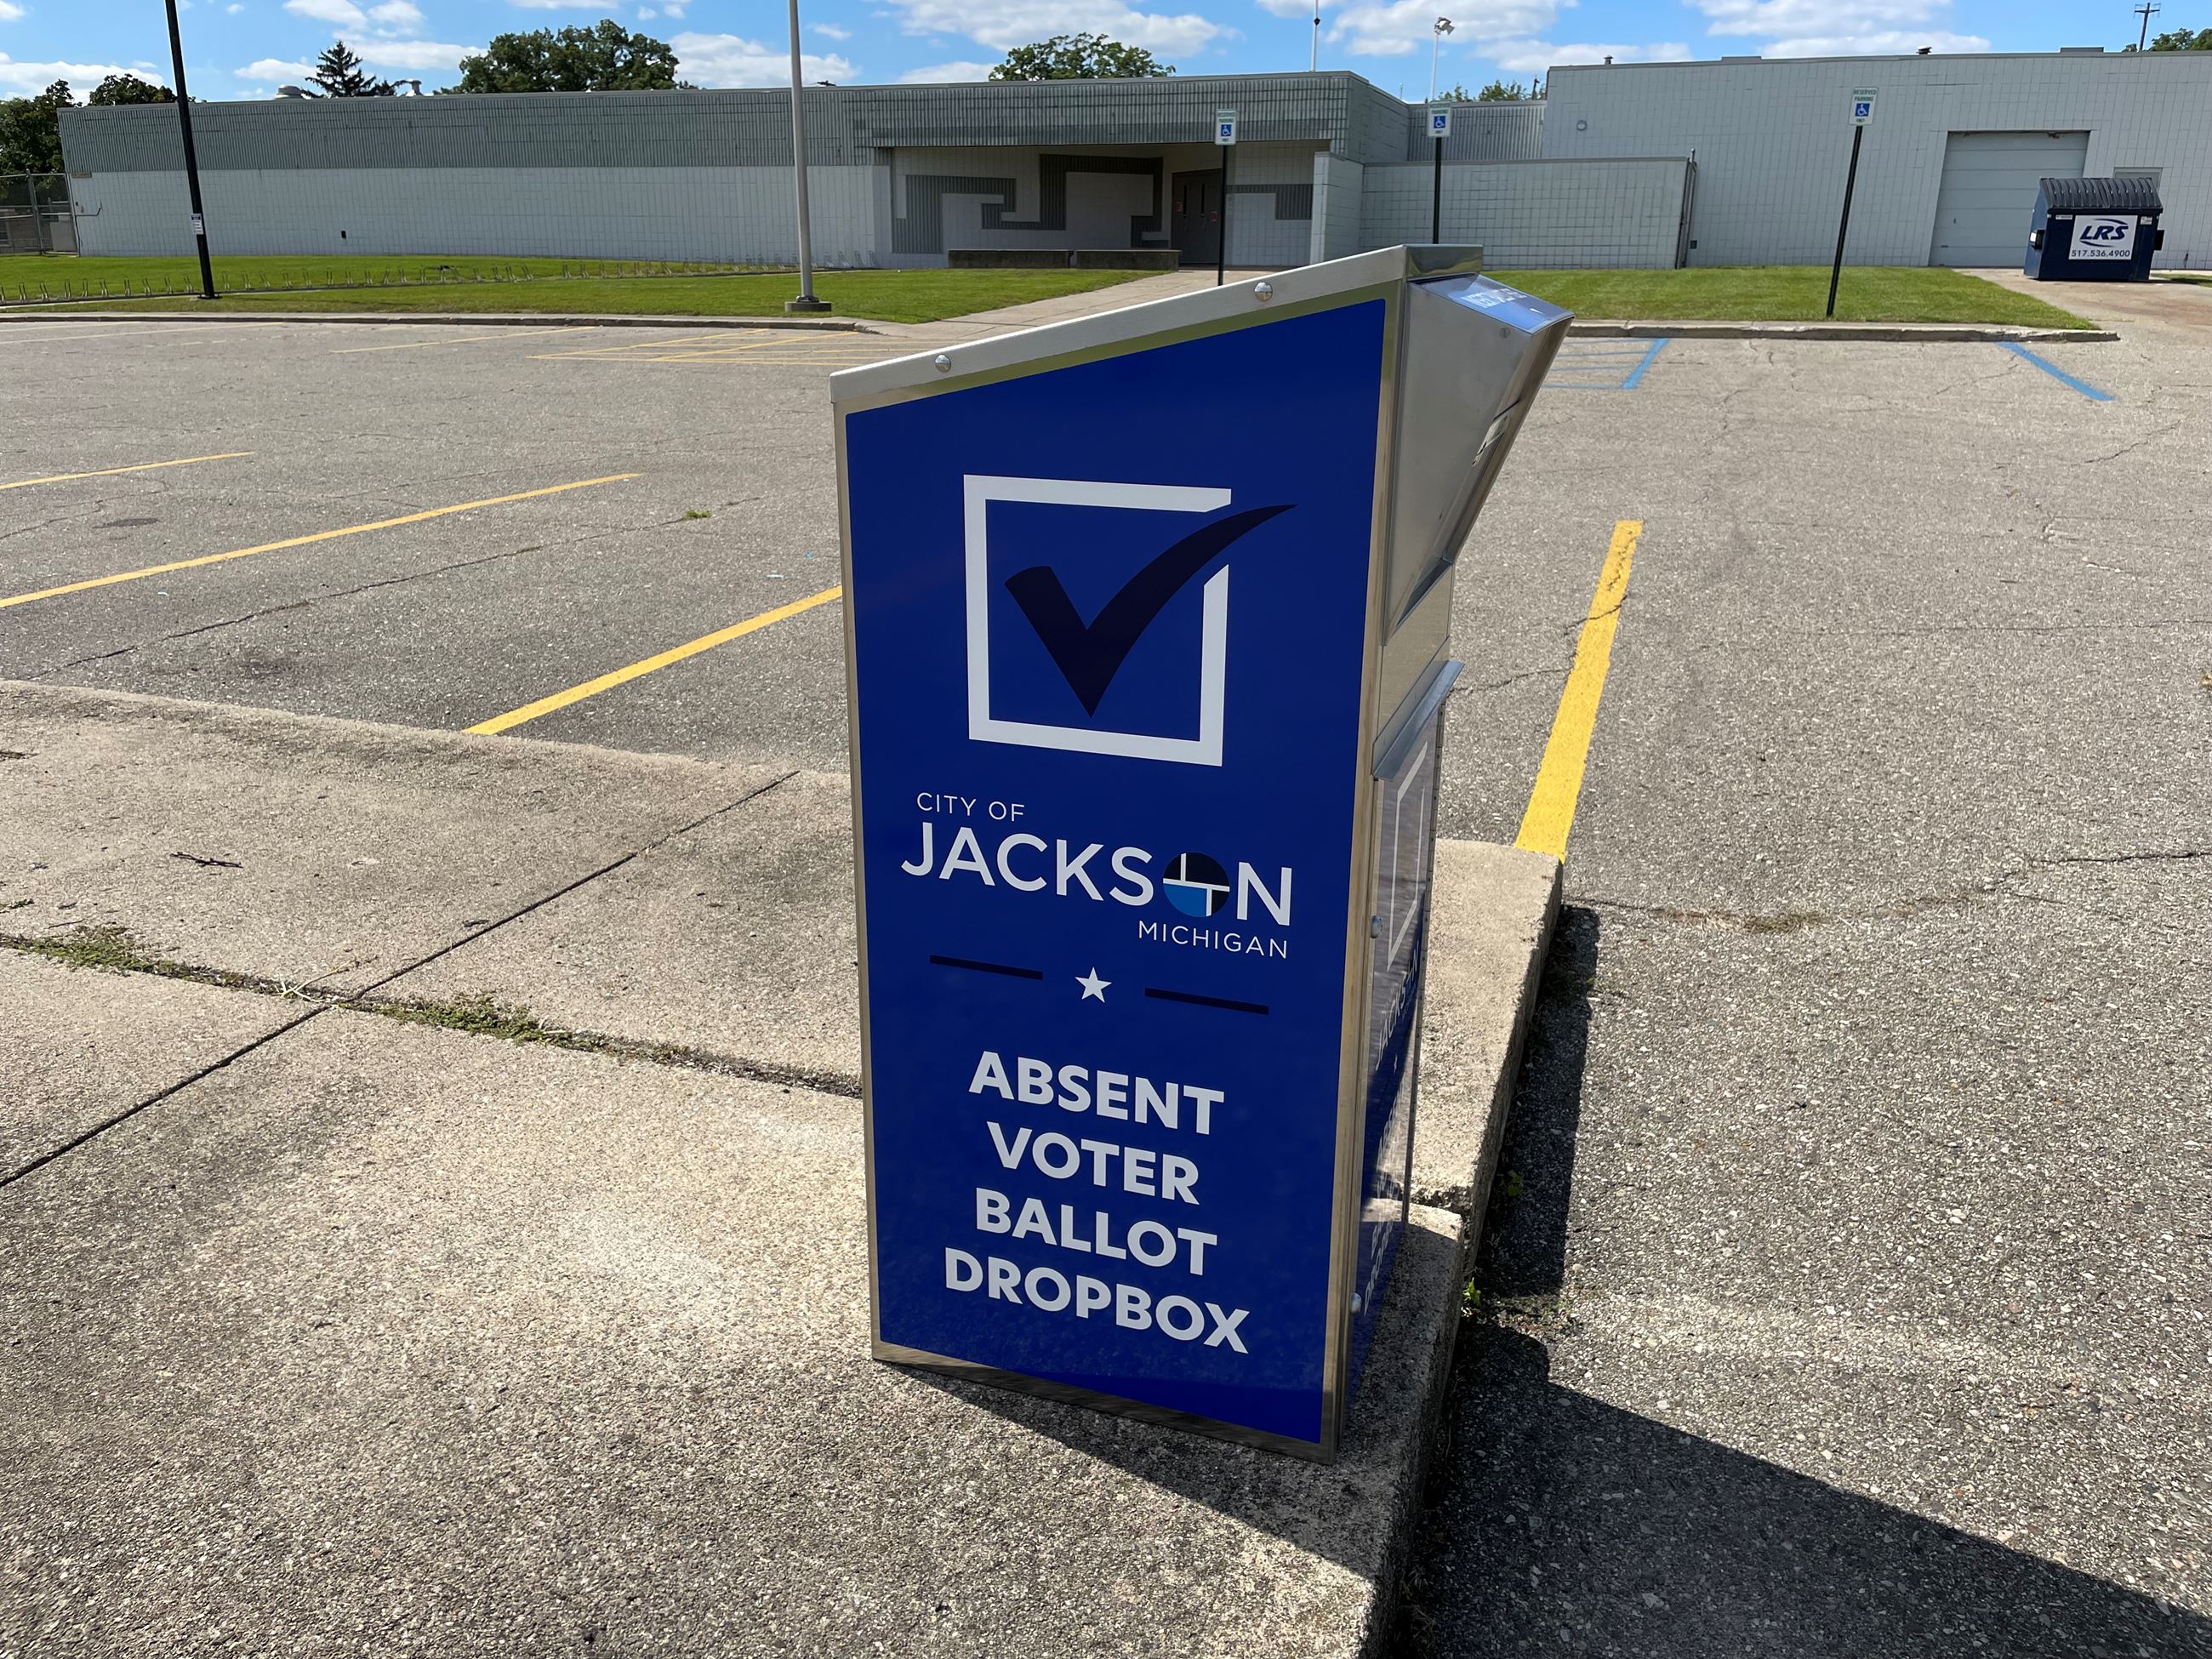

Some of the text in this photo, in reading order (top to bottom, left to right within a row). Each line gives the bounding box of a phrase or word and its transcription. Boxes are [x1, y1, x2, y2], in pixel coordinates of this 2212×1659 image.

[2072, 249, 2130, 258] 517.536.4900
[2080, 225, 2129, 240] LRS
[916, 792, 1025, 822] CITY OF
[901, 821, 1293, 926] JACKSON
[1138, 920, 1288, 959] MICHIGAN
[968, 1051, 1225, 1135] ABSENT
[986, 1120, 1200, 1206] VOTER
[976, 1187, 1217, 1276] BALLOT
[945, 1246, 1250, 1354] DROPBOX
